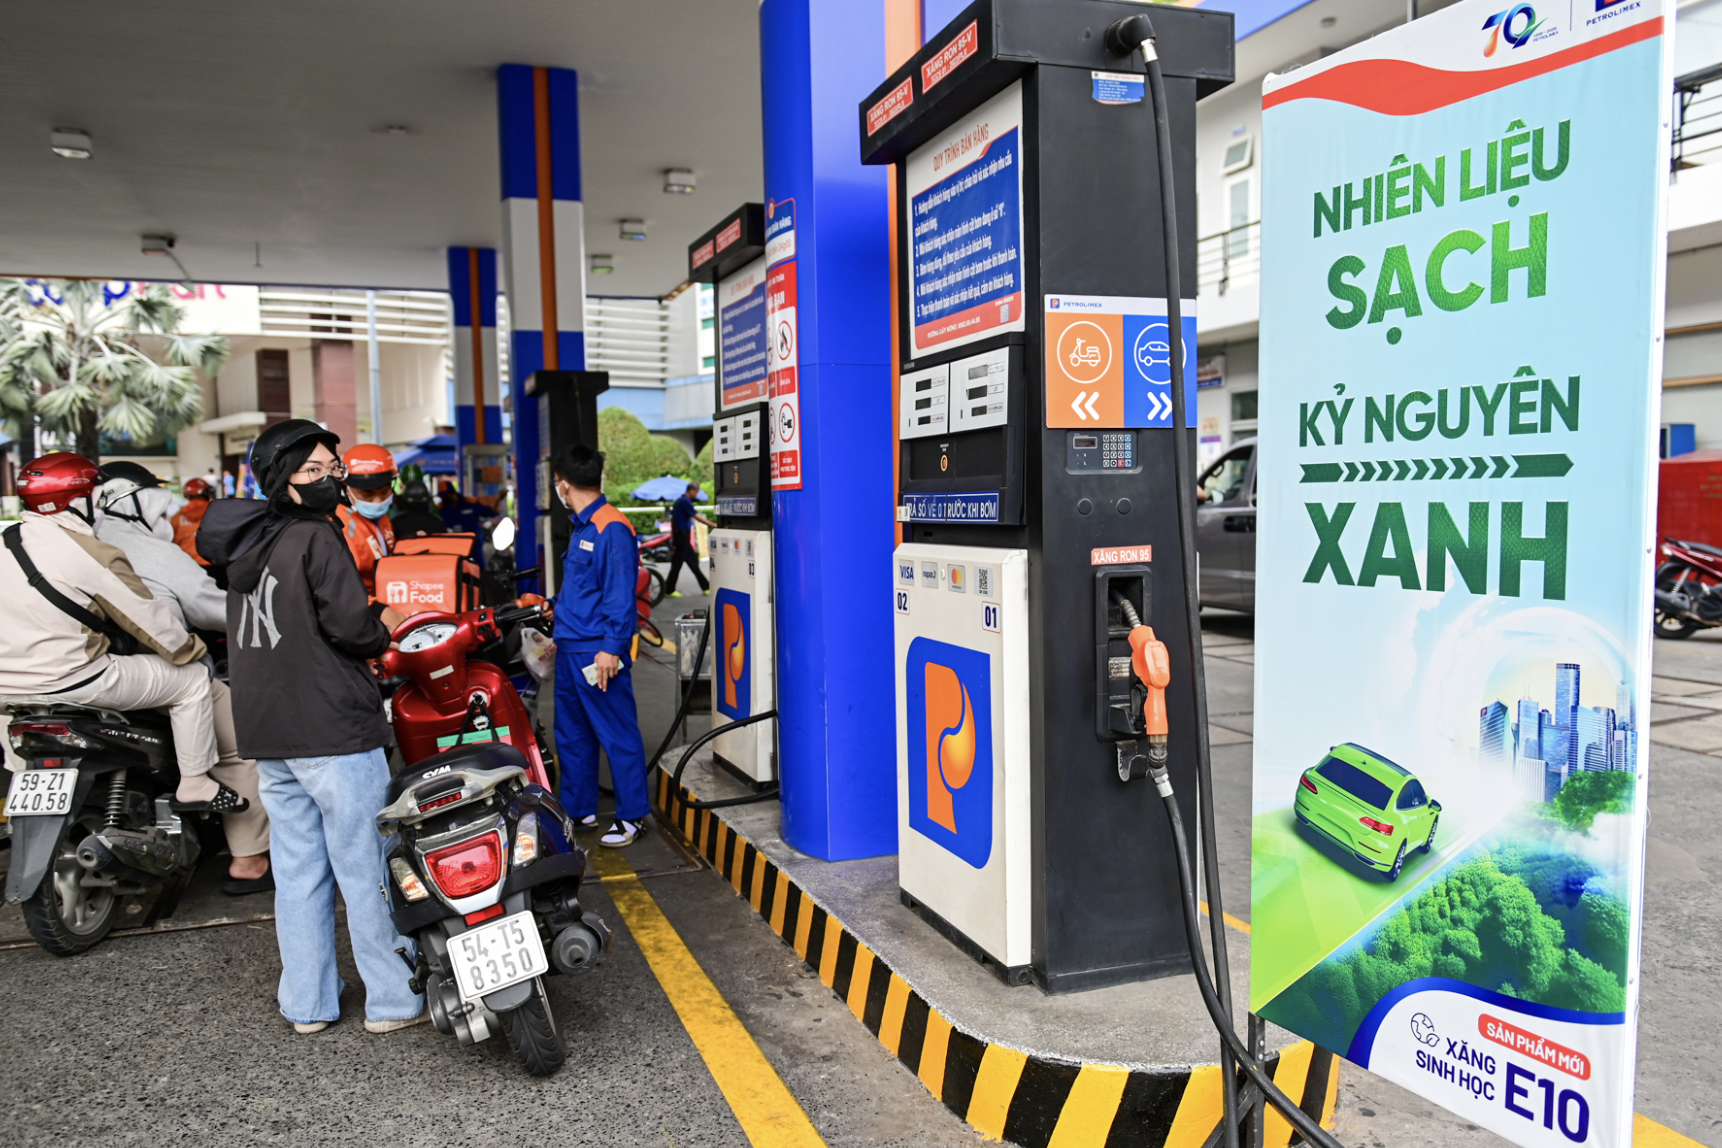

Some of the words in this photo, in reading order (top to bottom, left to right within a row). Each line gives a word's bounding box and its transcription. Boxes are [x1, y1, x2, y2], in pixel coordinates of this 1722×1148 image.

[1586, 1, 1641, 27] PETROLIMEX
[943, 43, 958, 63] RON
[958, 30, 972, 51] 95-V
[884, 94, 896, 115] RON
[896, 84, 908, 105] 95-V
[933, 152, 943, 172] QUY
[944, 142, 960, 165] TRÌNH
[961, 132, 973, 155] BÁN
[973, 123, 989, 144] HÀNG
[1313, 153, 1446, 239] NHIÊN
[1459, 118, 1571, 208] LIỆU
[1325, 211, 1549, 345] SẠCH
[1299, 382, 1355, 447] KỶ
[1364, 364, 1580, 444] NGUYÊN
[918, 498, 927, 517] SỐ
[967, 502, 978, 518] KHI
[980, 500, 996, 518] BƠM
[1093, 549, 1118, 564] XĂNG
[1120, 550, 1138, 562] RON
[1139, 549, 1149, 560] 95
[1301, 500, 1569, 601] XANH
[409, 581, 444, 592] Shopee
[900, 565, 914, 580] VISA
[410, 591, 443, 603] Food
[897, 592, 908, 611] 02
[985, 605, 997, 628] 01
[20, 773, 65, 791] 59-Z1
[422, 765, 451, 779] SYM
[9, 792, 68, 812] 440.58
[461, 919, 524, 962] 54-T5
[470, 947, 533, 990] 8350
[1446, 1036, 1496, 1075] XĂNG
[1486, 1021, 1515, 1046] SẢN
[1516, 1037, 1556, 1061] PHẨM
[1557, 1055, 1585, 1076] MỚI
[1415, 1049, 1455, 1084] SINH
[1459, 1068, 1495, 1101] HỌC
[1504, 1061, 1590, 1144] E10
